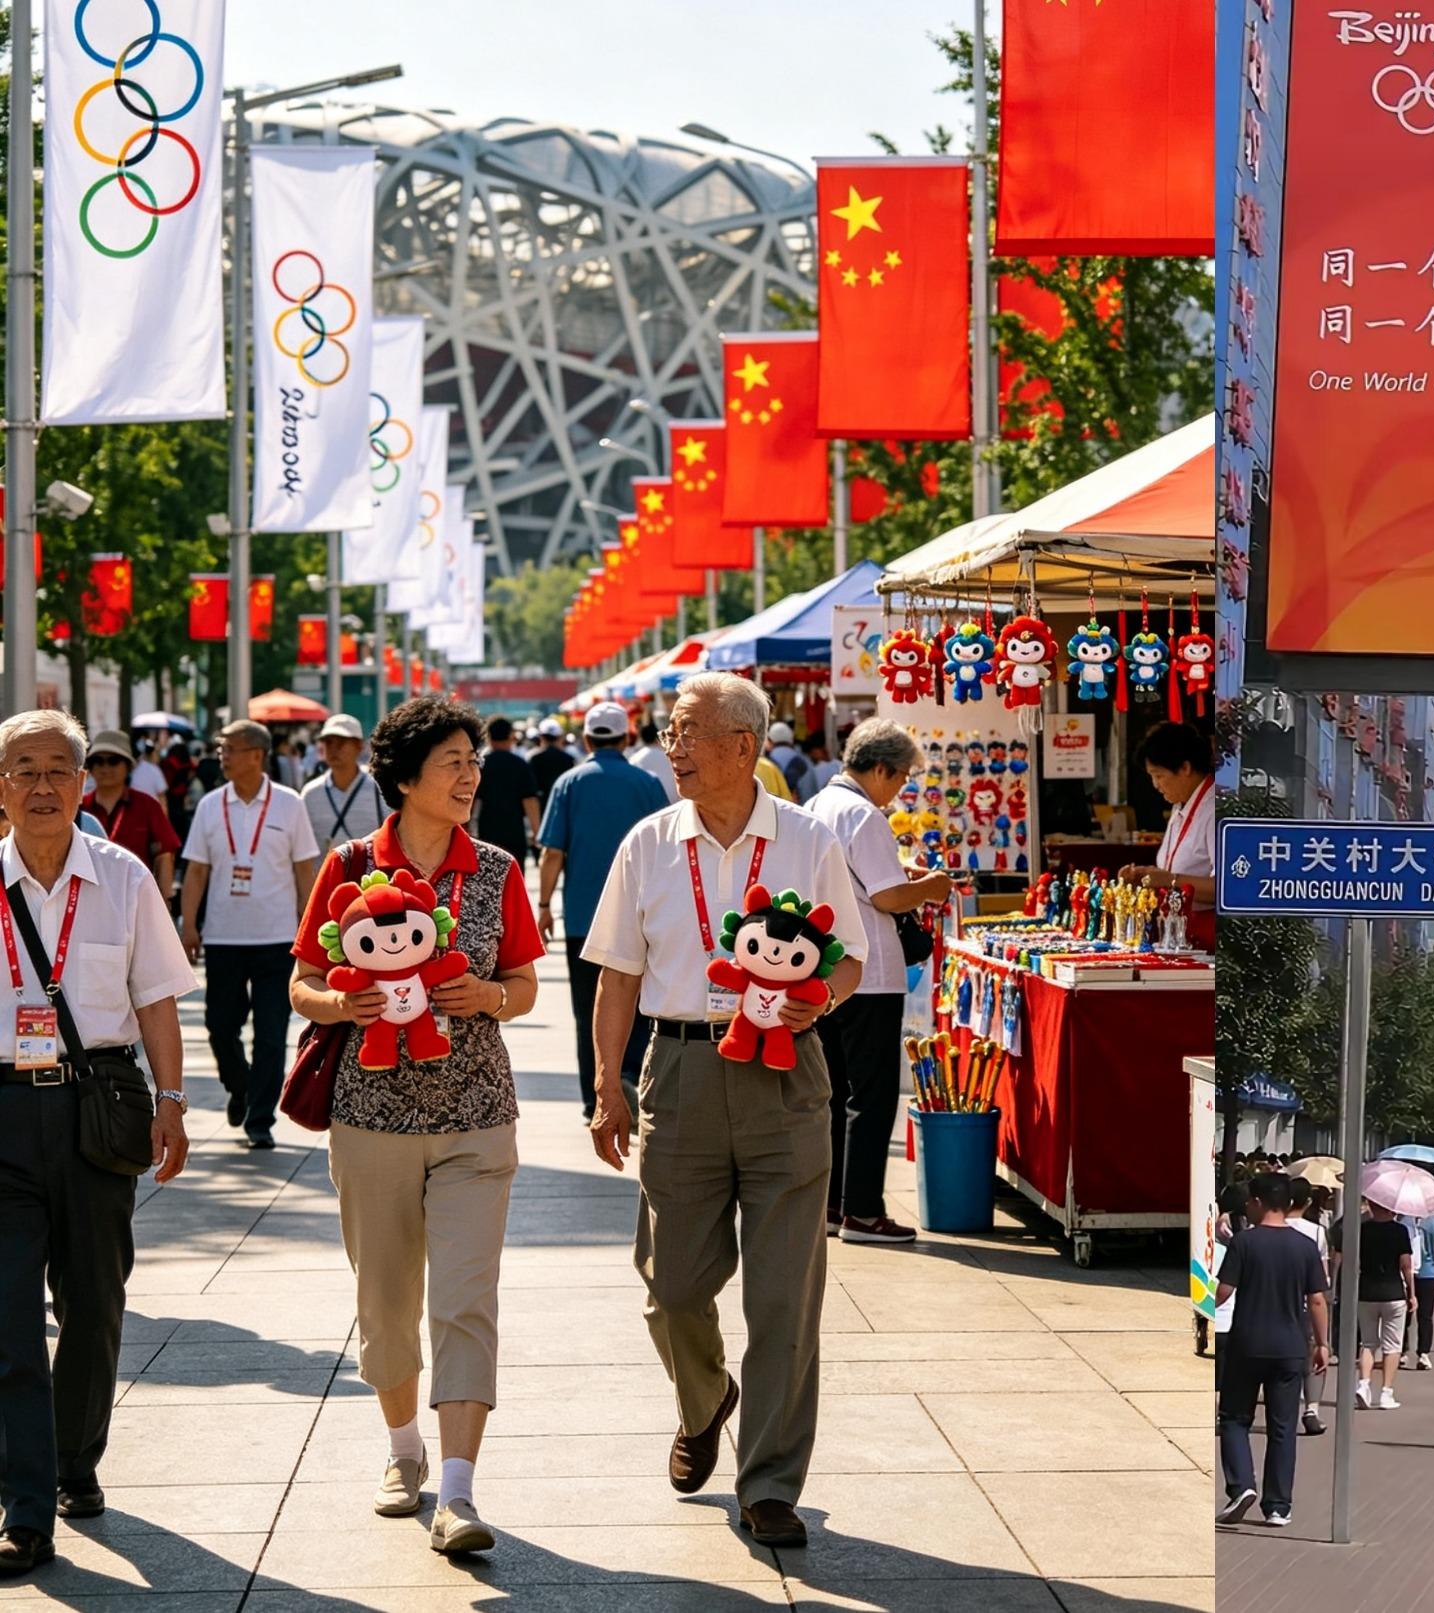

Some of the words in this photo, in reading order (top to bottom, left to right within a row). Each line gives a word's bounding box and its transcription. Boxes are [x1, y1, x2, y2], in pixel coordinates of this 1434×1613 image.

[1308, 370, 1353, 391] One
[1363, 372, 1428, 393] World
[1258, 879, 1404, 902] ZHONGGUANCUN
